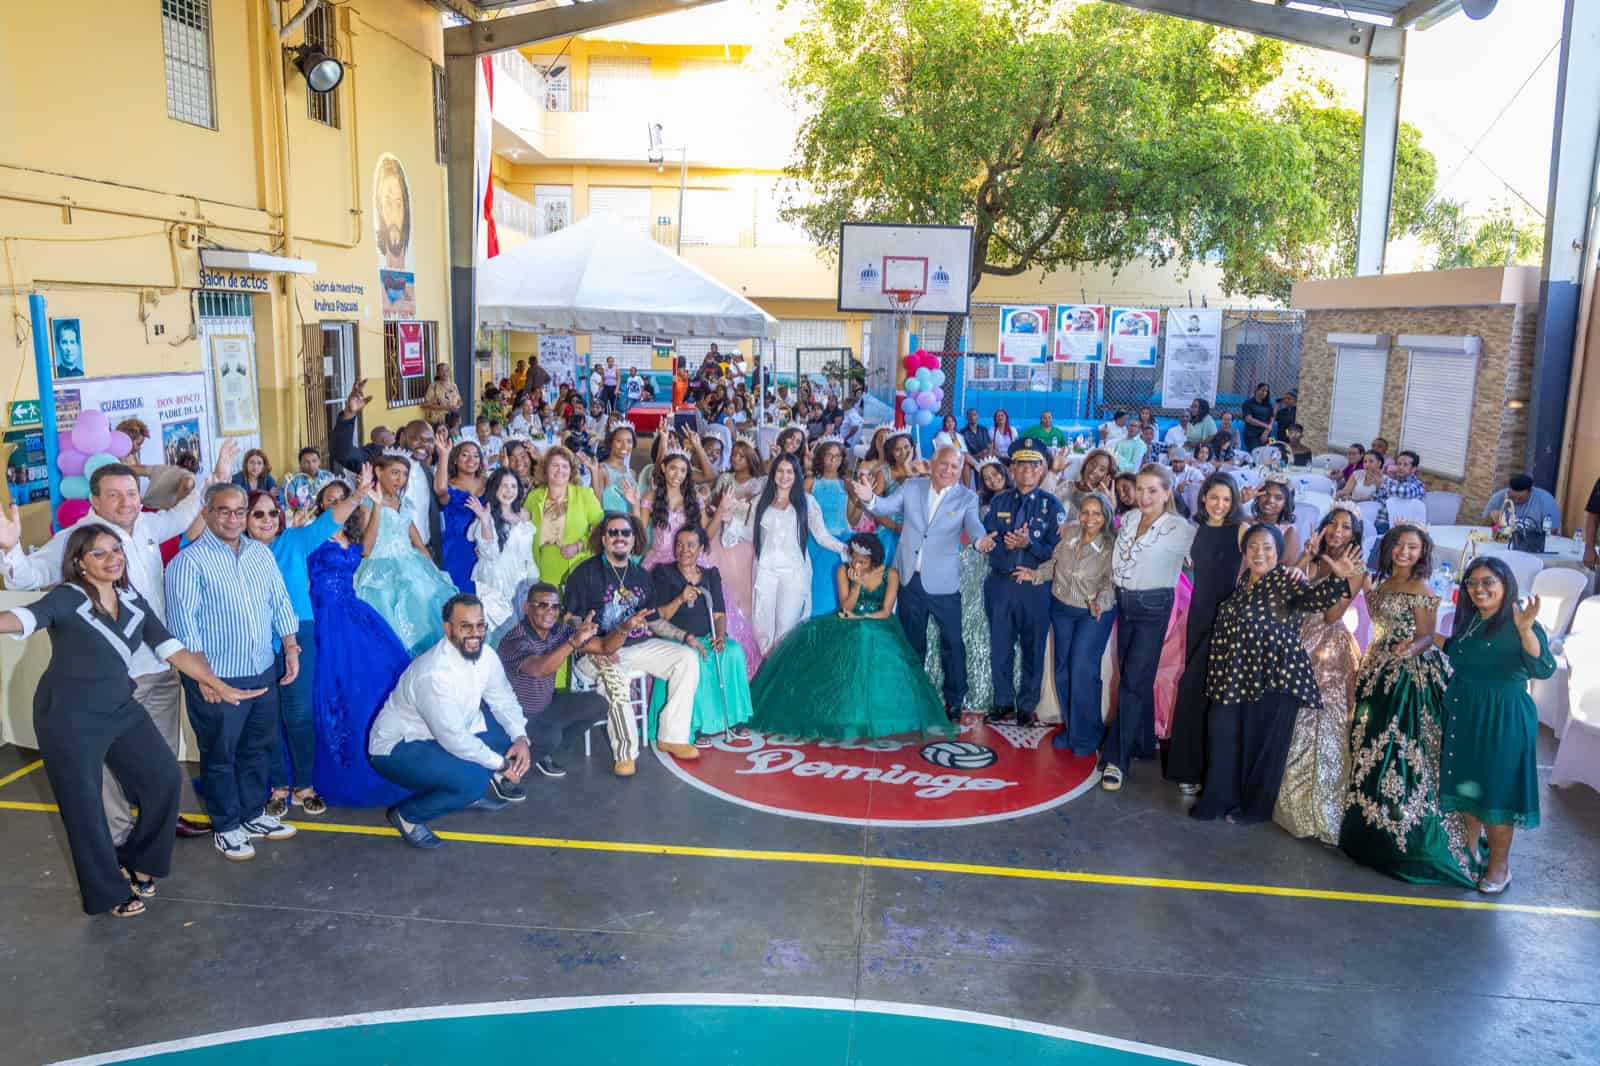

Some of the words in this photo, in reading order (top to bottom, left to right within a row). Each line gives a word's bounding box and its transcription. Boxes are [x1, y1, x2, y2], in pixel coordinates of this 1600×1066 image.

[228, 271, 238, 288] de
[240, 273, 268, 289] actos
[101, 396, 144, 412] CUARESMA
[157, 398, 173, 409] DON
[176, 393, 200, 405] BOSCO
[159, 408, 181, 421] PADRE
[182, 406, 192, 415] DE
[194, 404, 204, 413] LA
[735, 749, 1019, 799] Domingo
